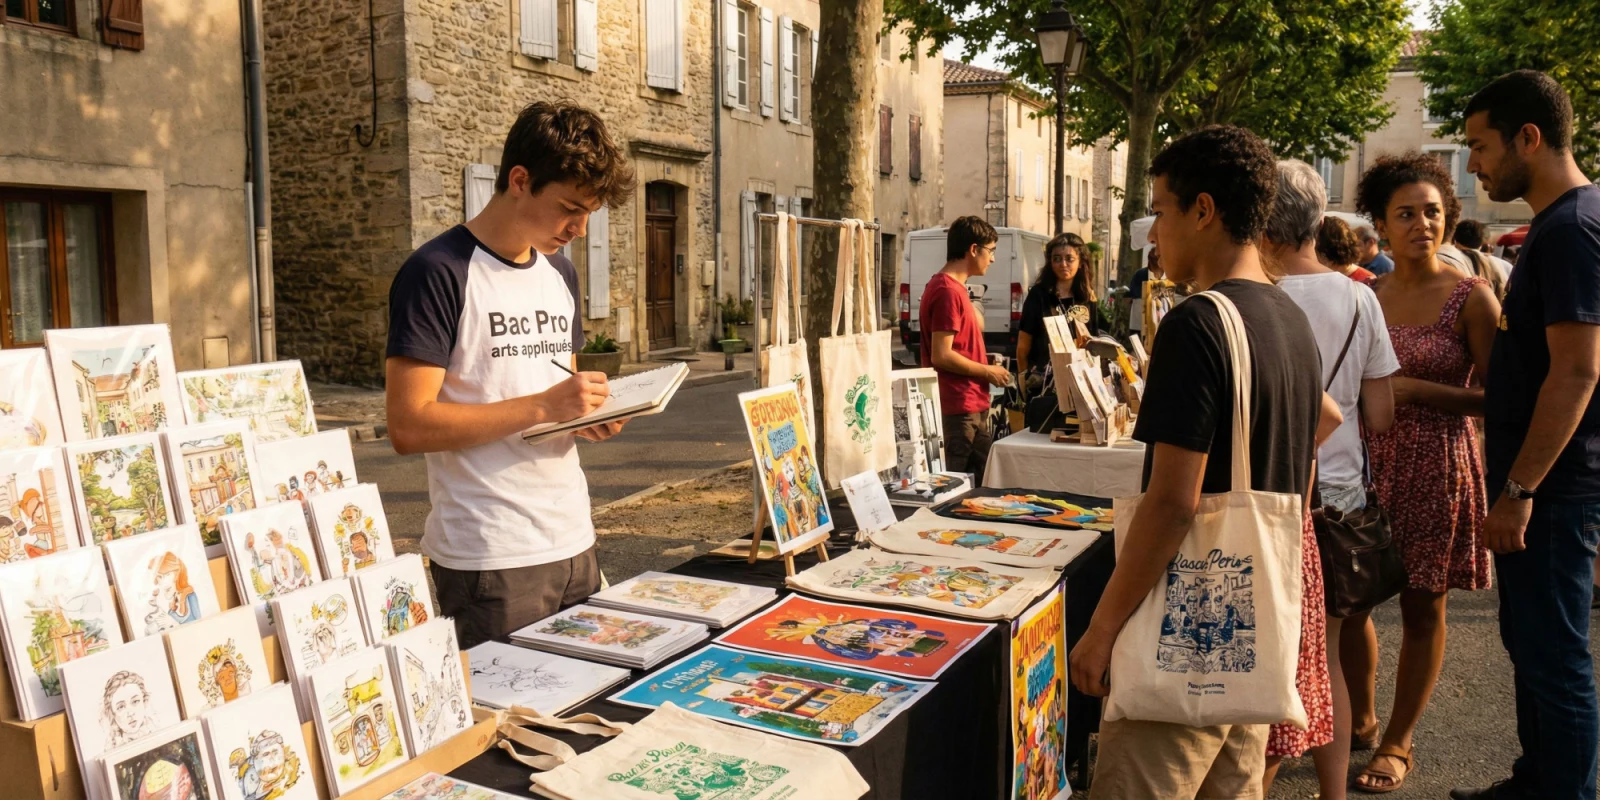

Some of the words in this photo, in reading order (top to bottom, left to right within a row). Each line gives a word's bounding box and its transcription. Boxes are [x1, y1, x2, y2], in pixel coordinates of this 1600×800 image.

[488, 311, 531, 337] Bac
[535, 310, 568, 334] Pro
[491, 343, 519, 358] arts
[521, 338, 572, 359] appliqués
